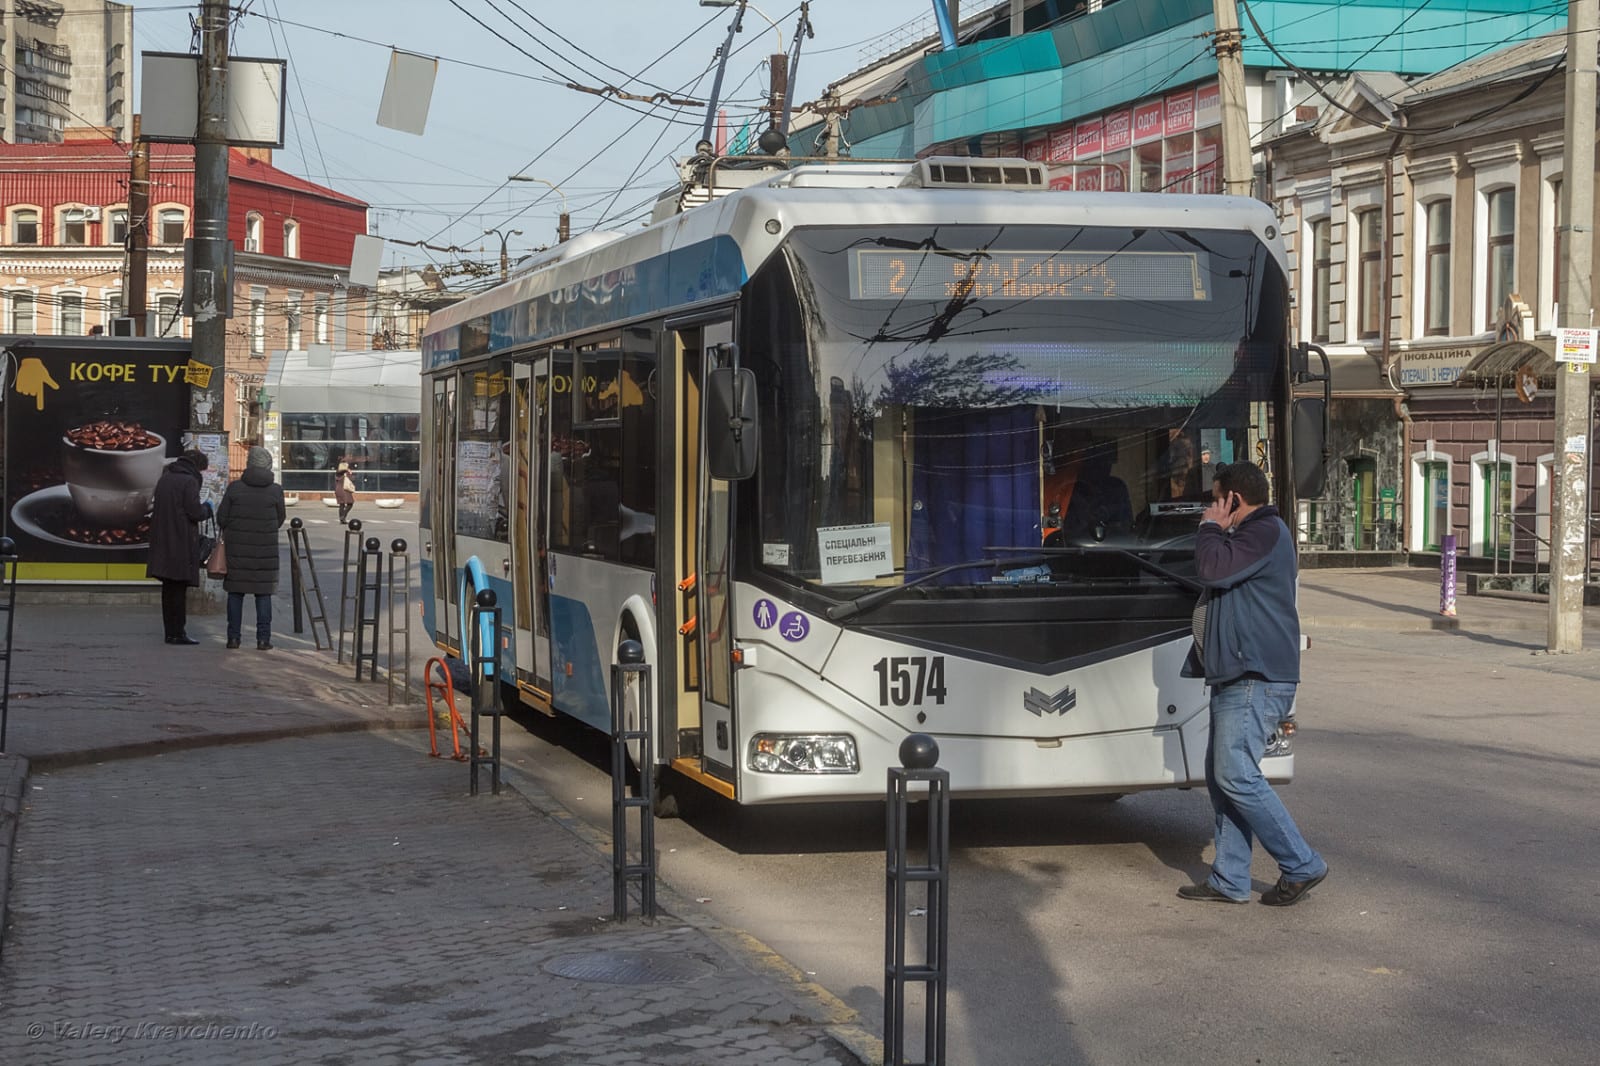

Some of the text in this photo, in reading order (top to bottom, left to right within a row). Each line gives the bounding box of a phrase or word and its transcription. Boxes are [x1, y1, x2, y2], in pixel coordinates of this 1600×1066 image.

[1138, 110, 1159, 131] ОДЯГ
[1168, 112, 1192, 129] ЦЕНТР
[1106, 131, 1128, 147] ЦЕНТР
[889, 258, 907, 293] 2
[1003, 278, 1071, 297] Парус
[70, 362, 136, 382] КОФЕ
[148, 365, 190, 383] ТУТ
[825, 536, 876, 551] СПЕЦІАЛЬНІ
[826, 551, 886, 566] ПЕРЕВЕЗЕННЯ
[873, 656, 947, 706] 1574
